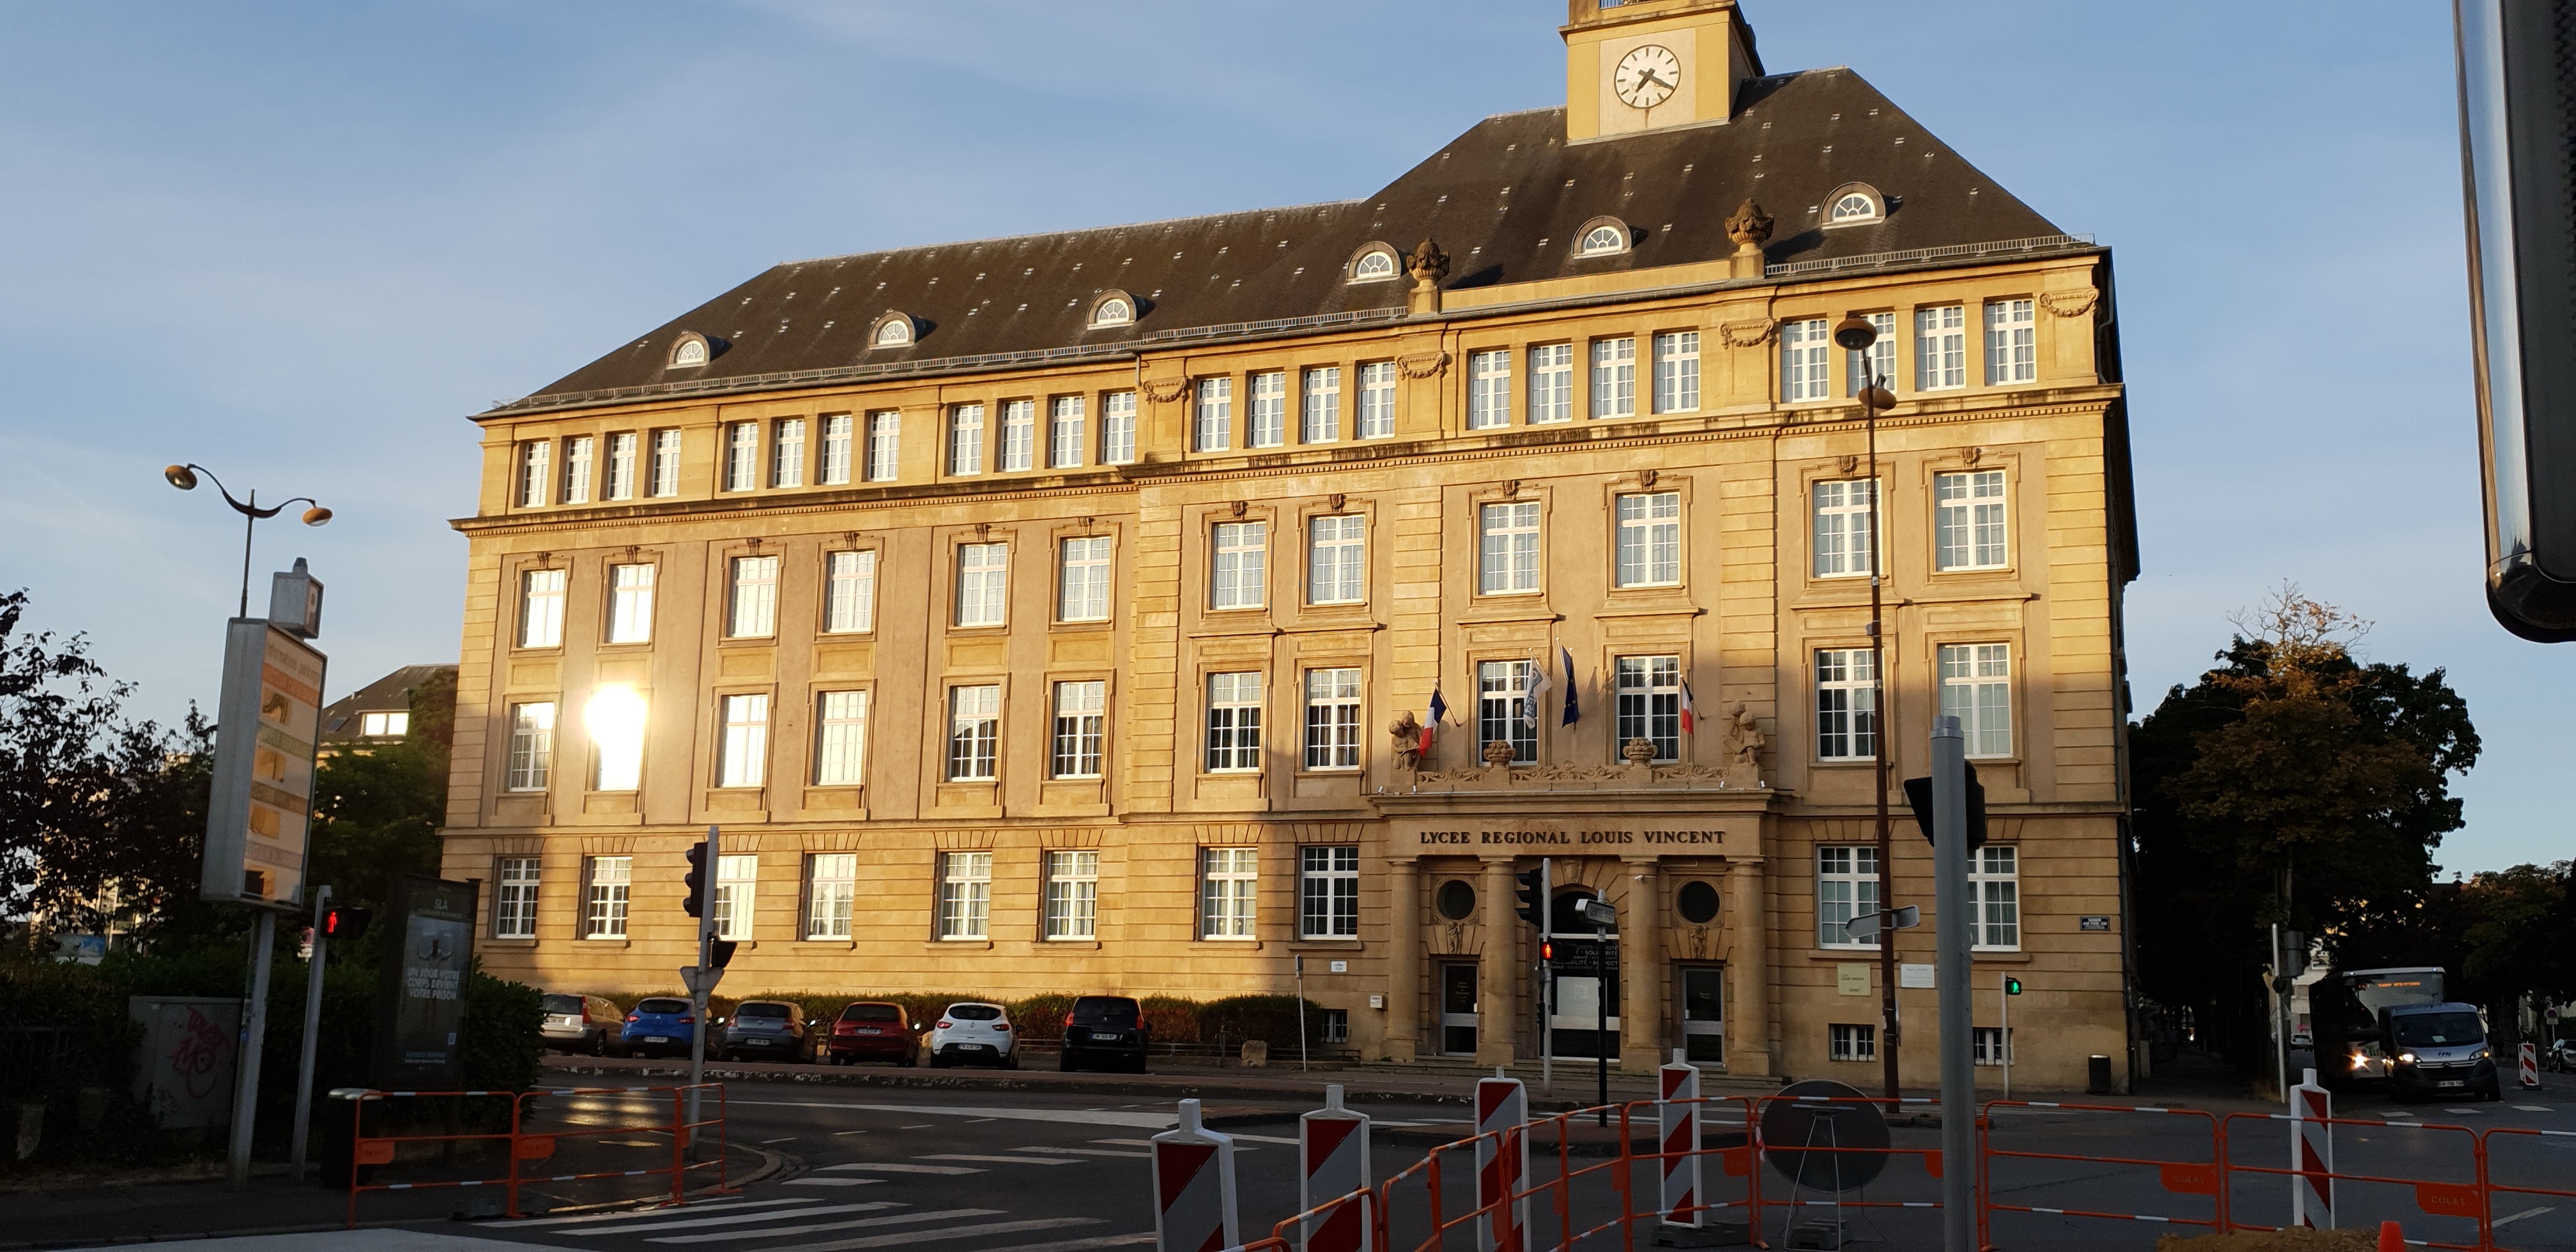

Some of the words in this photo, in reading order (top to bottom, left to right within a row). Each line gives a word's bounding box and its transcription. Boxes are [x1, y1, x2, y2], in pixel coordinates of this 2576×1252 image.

[1420, 831, 1470, 844] LYCEE
[1481, 831, 1570, 844] REGIONAL
[1581, 830, 1634, 844] LOUIS
[1644, 830, 1726, 843] VINCENT
[434, 897, 448, 910] SLA
[407, 966, 418, 977] UN
[419, 967, 438, 979] JOUR
[440, 969, 461, 981] VOTRE
[408, 977, 430, 989] CORPS
[431, 979, 459, 991] DEVIENT
[410, 988, 431, 999] VOTRE
[432, 989, 457, 1001] PRISON
